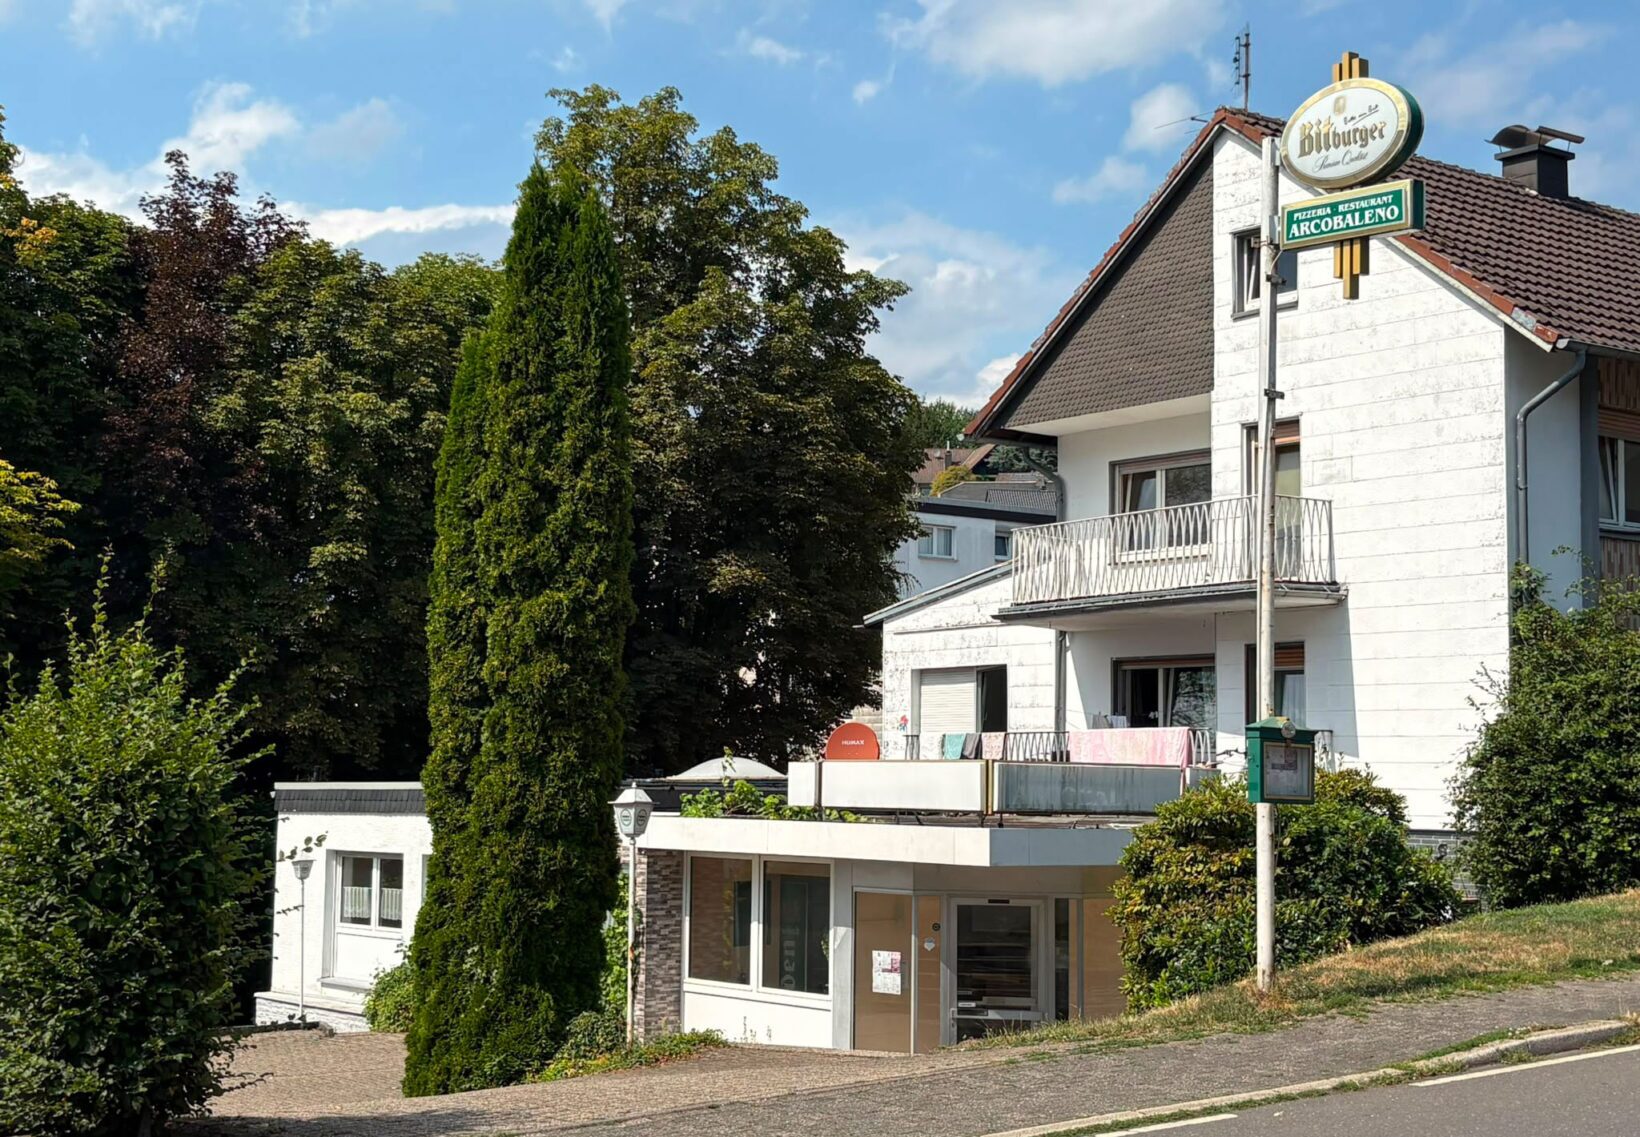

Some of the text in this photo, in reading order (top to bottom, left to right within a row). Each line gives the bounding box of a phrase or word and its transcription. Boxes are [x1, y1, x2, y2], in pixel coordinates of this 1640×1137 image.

[1297, 115, 1387, 158] Bitburger
[1288, 205, 1400, 238] ARCOBALENO
[1293, 195, 1394, 221] PIZZERIA RESTAURANT
